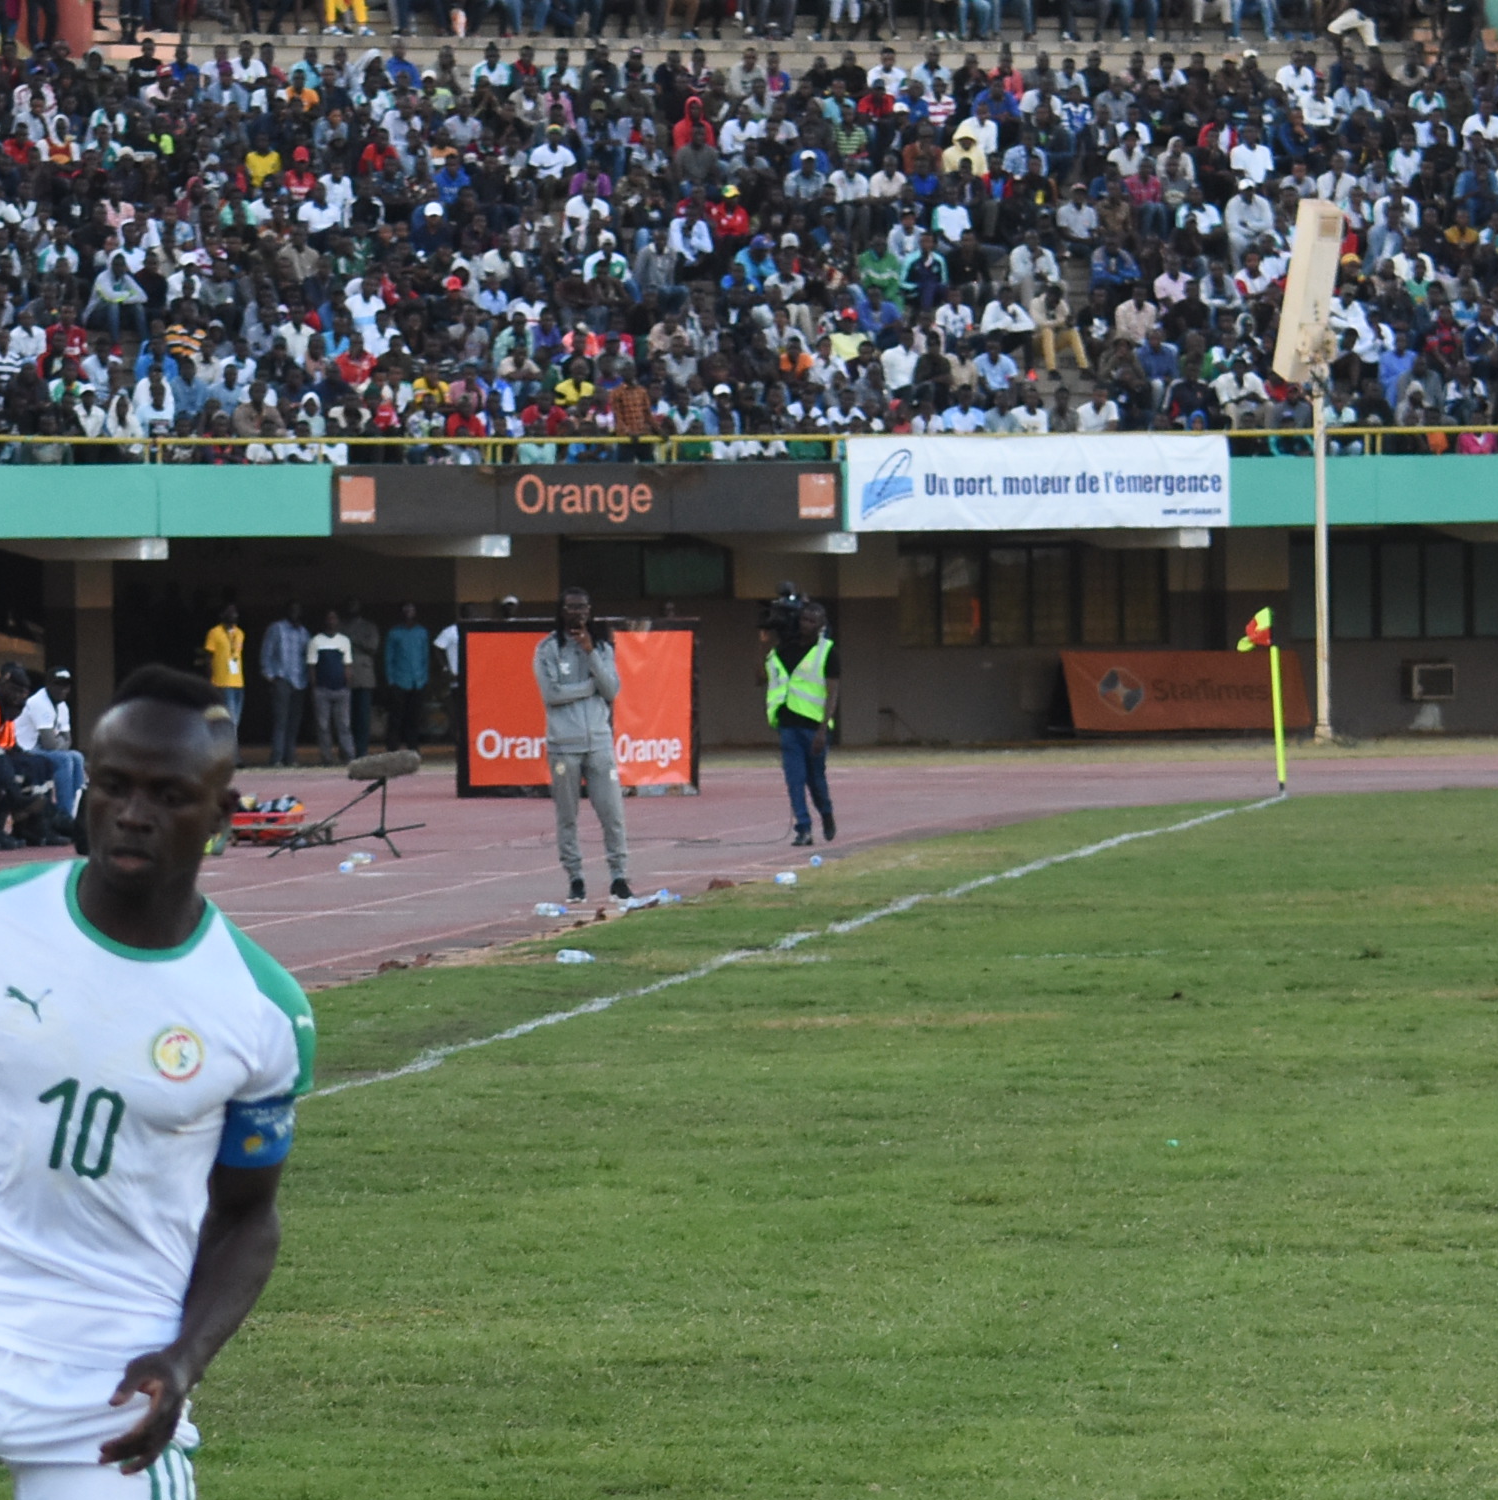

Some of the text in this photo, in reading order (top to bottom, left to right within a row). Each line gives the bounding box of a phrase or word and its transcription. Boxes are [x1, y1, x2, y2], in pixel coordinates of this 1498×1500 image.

[515, 474, 653, 523] Orange
[924, 470, 1222, 499] Un port, moteur de l'émergence
[615, 733, 683, 768] Orange
[38, 1077, 126, 1180] 10
